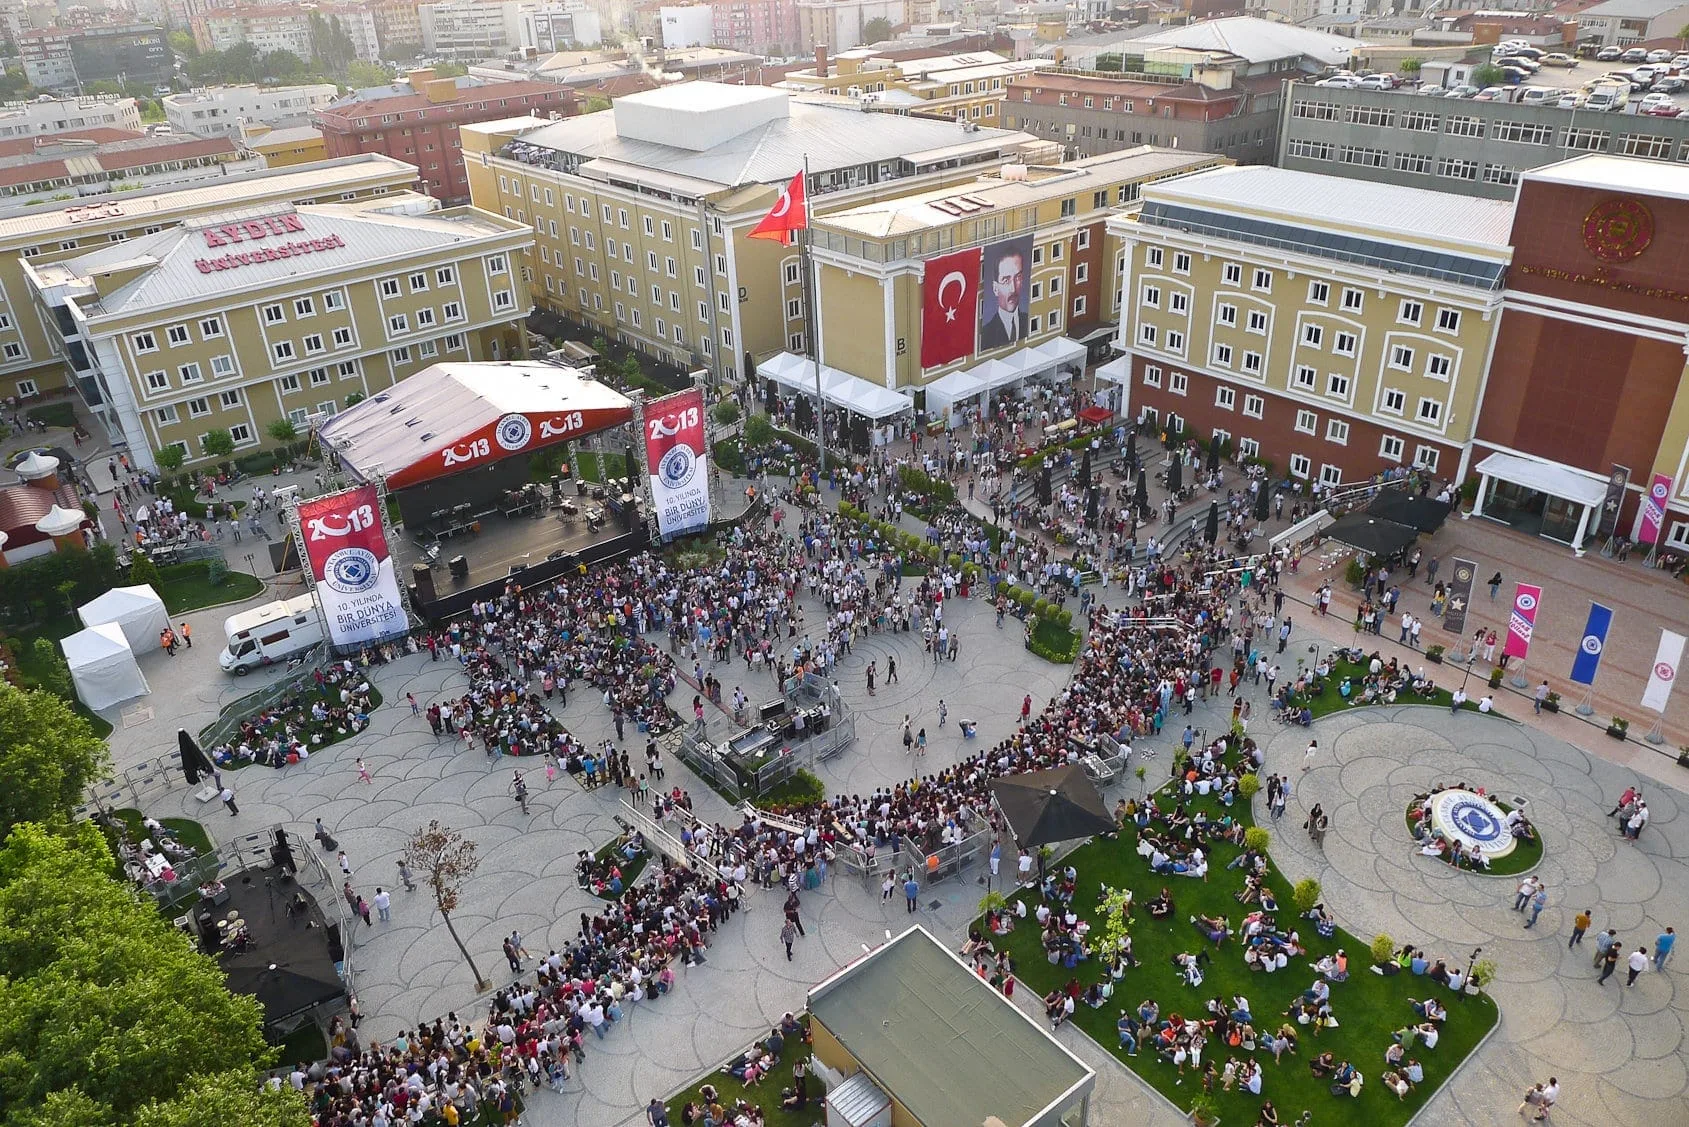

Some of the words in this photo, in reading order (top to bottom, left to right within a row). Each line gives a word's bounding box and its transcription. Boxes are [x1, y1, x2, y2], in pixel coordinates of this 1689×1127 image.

[203, 213, 305, 248] AYDIN
[195, 233, 345, 274] ÜNİVERSİTESİ
[738, 287, 747, 298] D
[897, 337, 905, 351] B
[337, 602, 350, 612] 10.
[351, 593, 383, 608] YILINDA
[337, 611, 356, 624] BİR
[358, 601, 394, 619] DÜNYA
[340, 610, 397, 633] ÜNİVERSİTESİ
